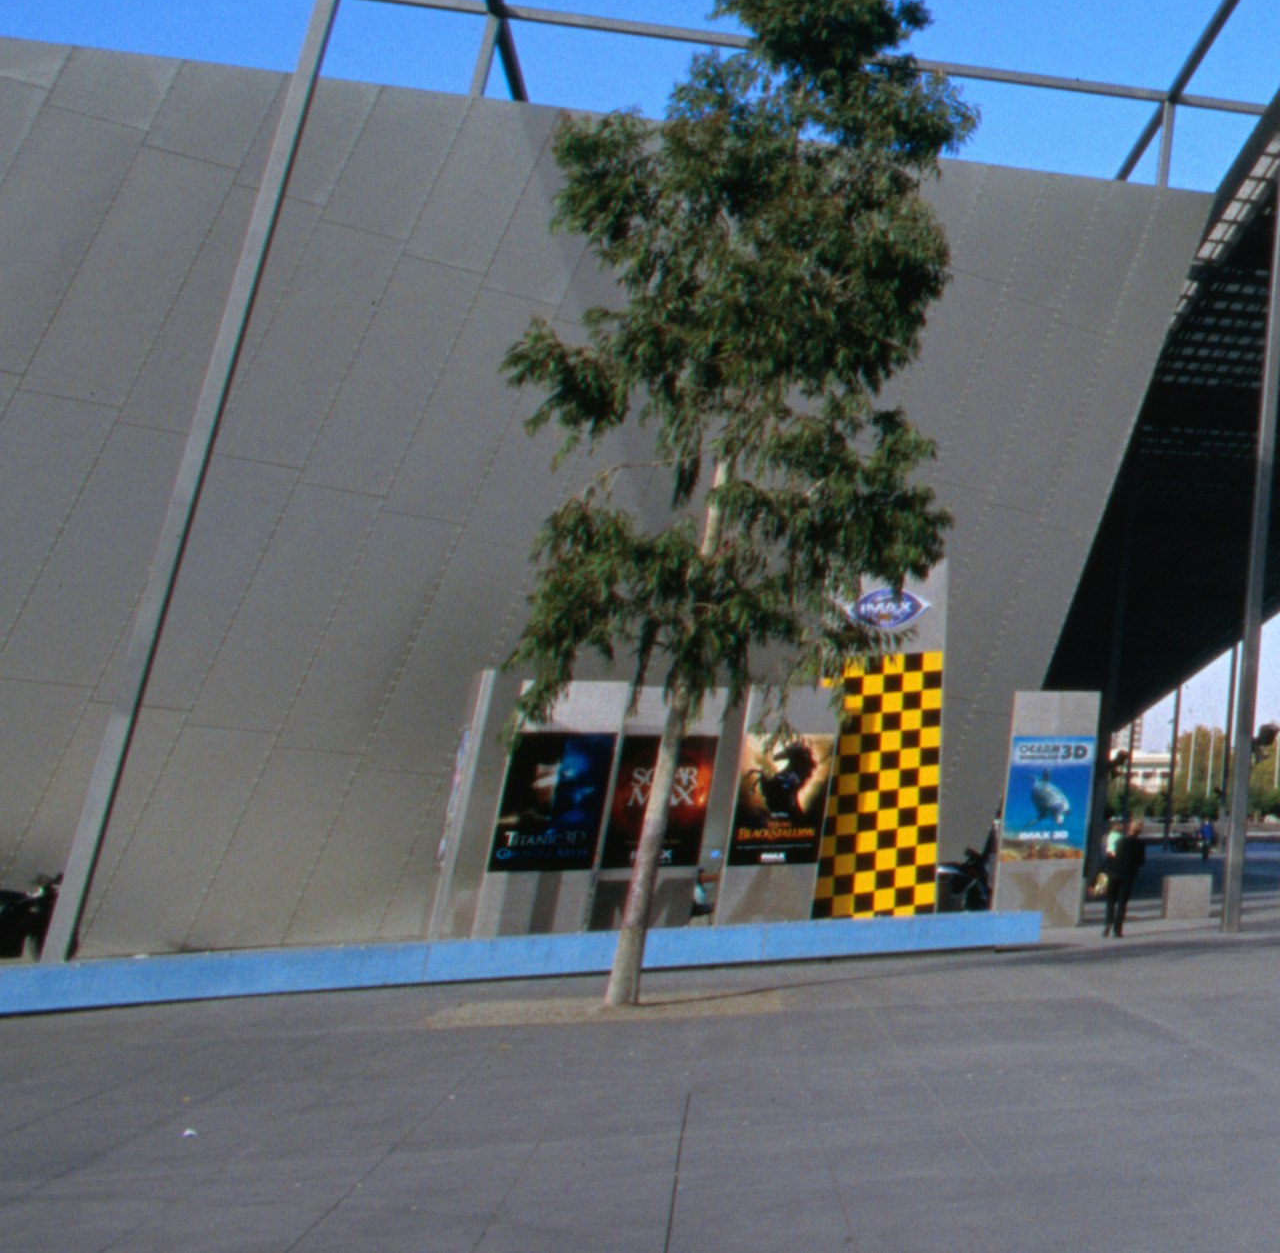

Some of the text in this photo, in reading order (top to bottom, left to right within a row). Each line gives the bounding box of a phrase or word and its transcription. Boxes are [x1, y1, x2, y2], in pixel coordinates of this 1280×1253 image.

[1020, 744, 1060, 754] OCEAN
[1061, 744, 1088, 760] 3D
[631, 766, 698, 787] SAR
[1019, 831, 1050, 840] IMAX
